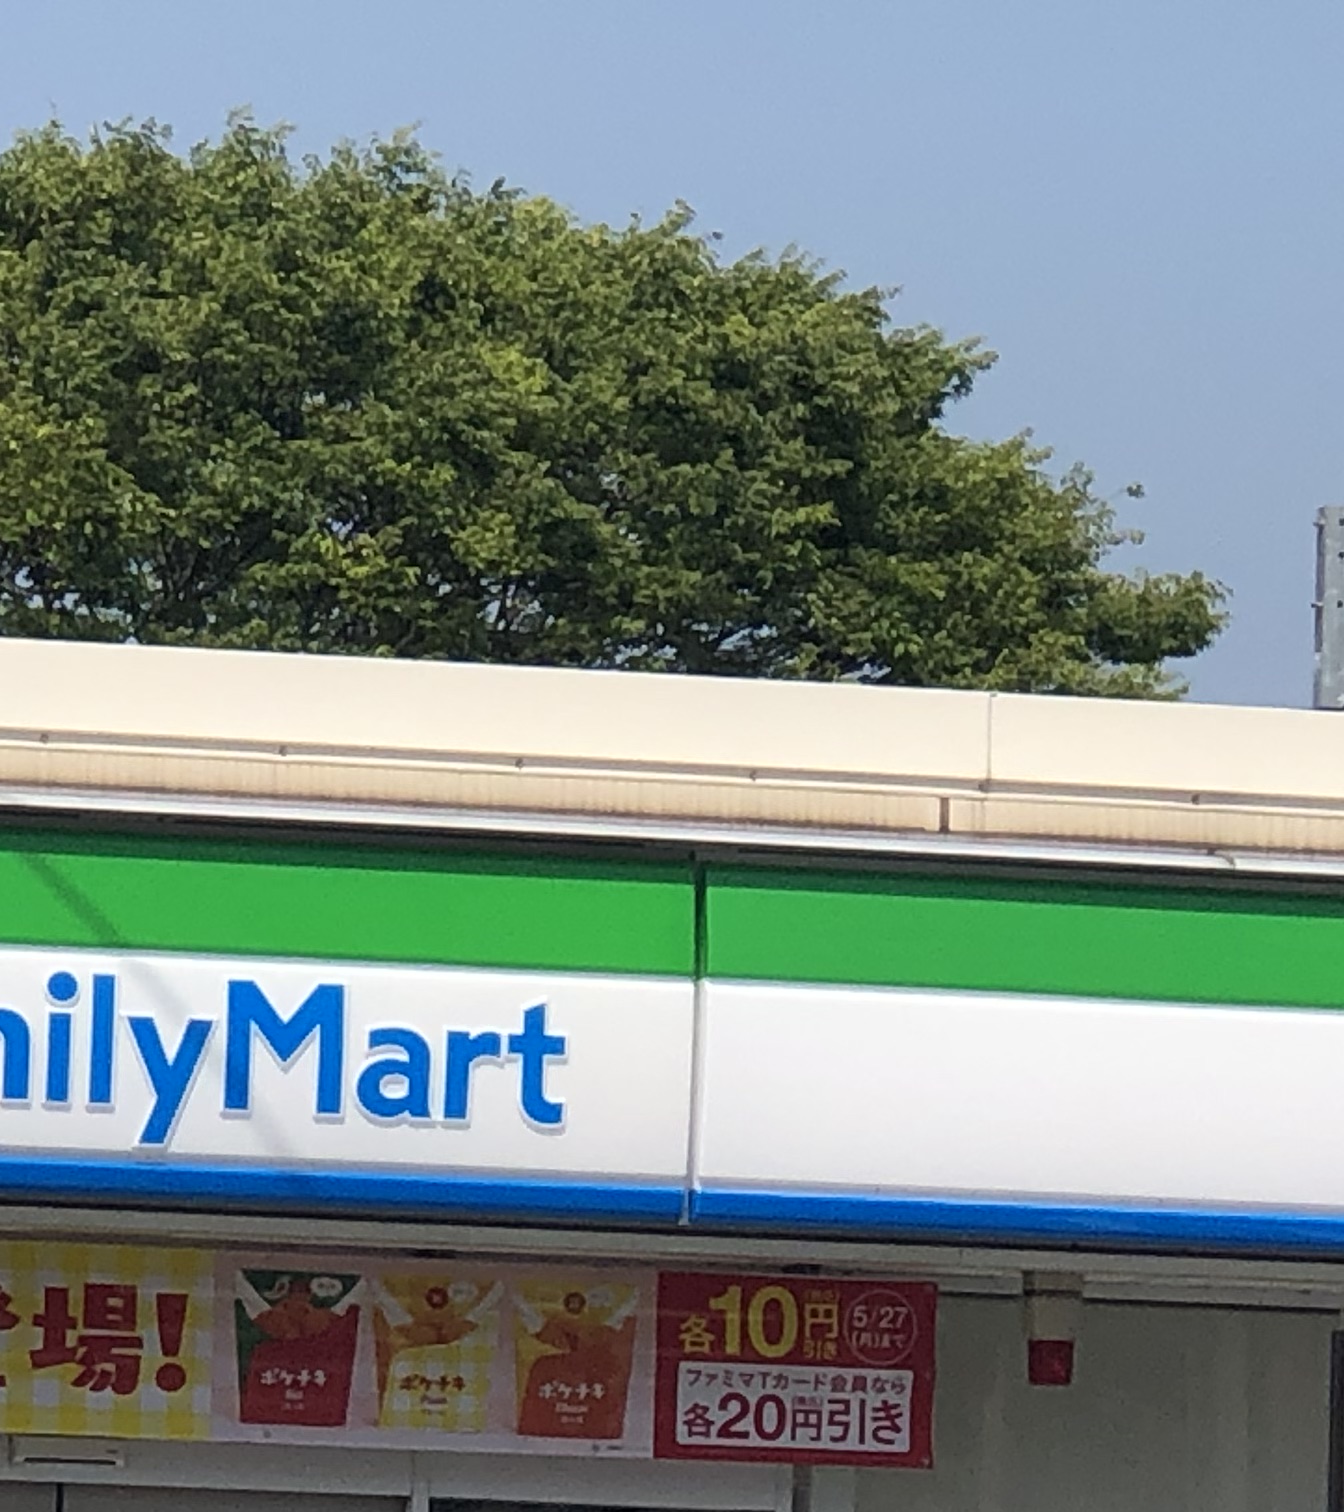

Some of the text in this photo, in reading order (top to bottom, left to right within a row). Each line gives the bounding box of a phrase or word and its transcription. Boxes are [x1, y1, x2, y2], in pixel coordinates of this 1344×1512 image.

[853, 1306, 907, 1330] 5/27
[686, 1369, 907, 1395] ファミマTカード会員なら
